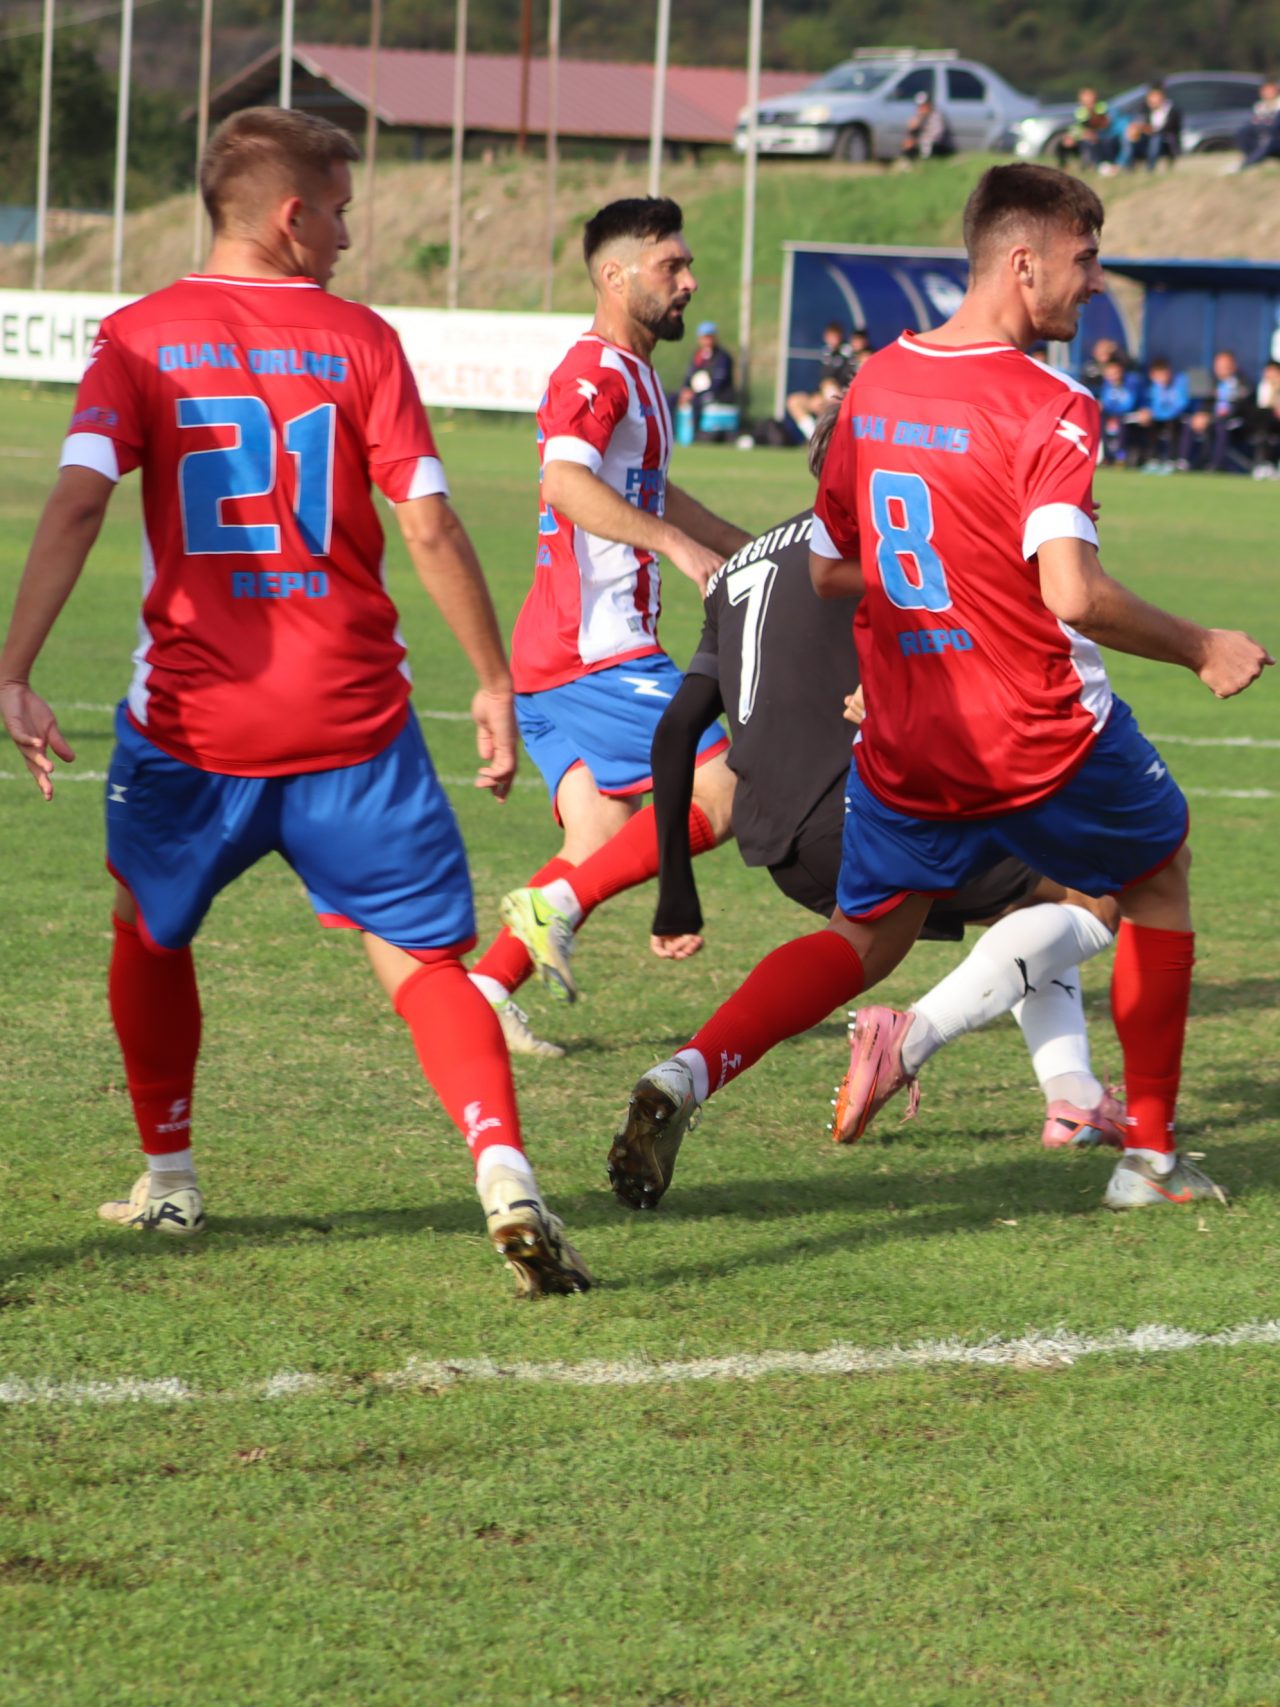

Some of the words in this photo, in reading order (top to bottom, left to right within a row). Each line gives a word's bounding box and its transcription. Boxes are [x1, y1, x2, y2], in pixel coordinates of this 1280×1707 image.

[176, 396, 336, 557] 21
[869, 468, 954, 613] 8
[231, 571, 330, 599] REPO
[726, 558, 779, 725] 7
[897, 628, 974, 657] REPO
